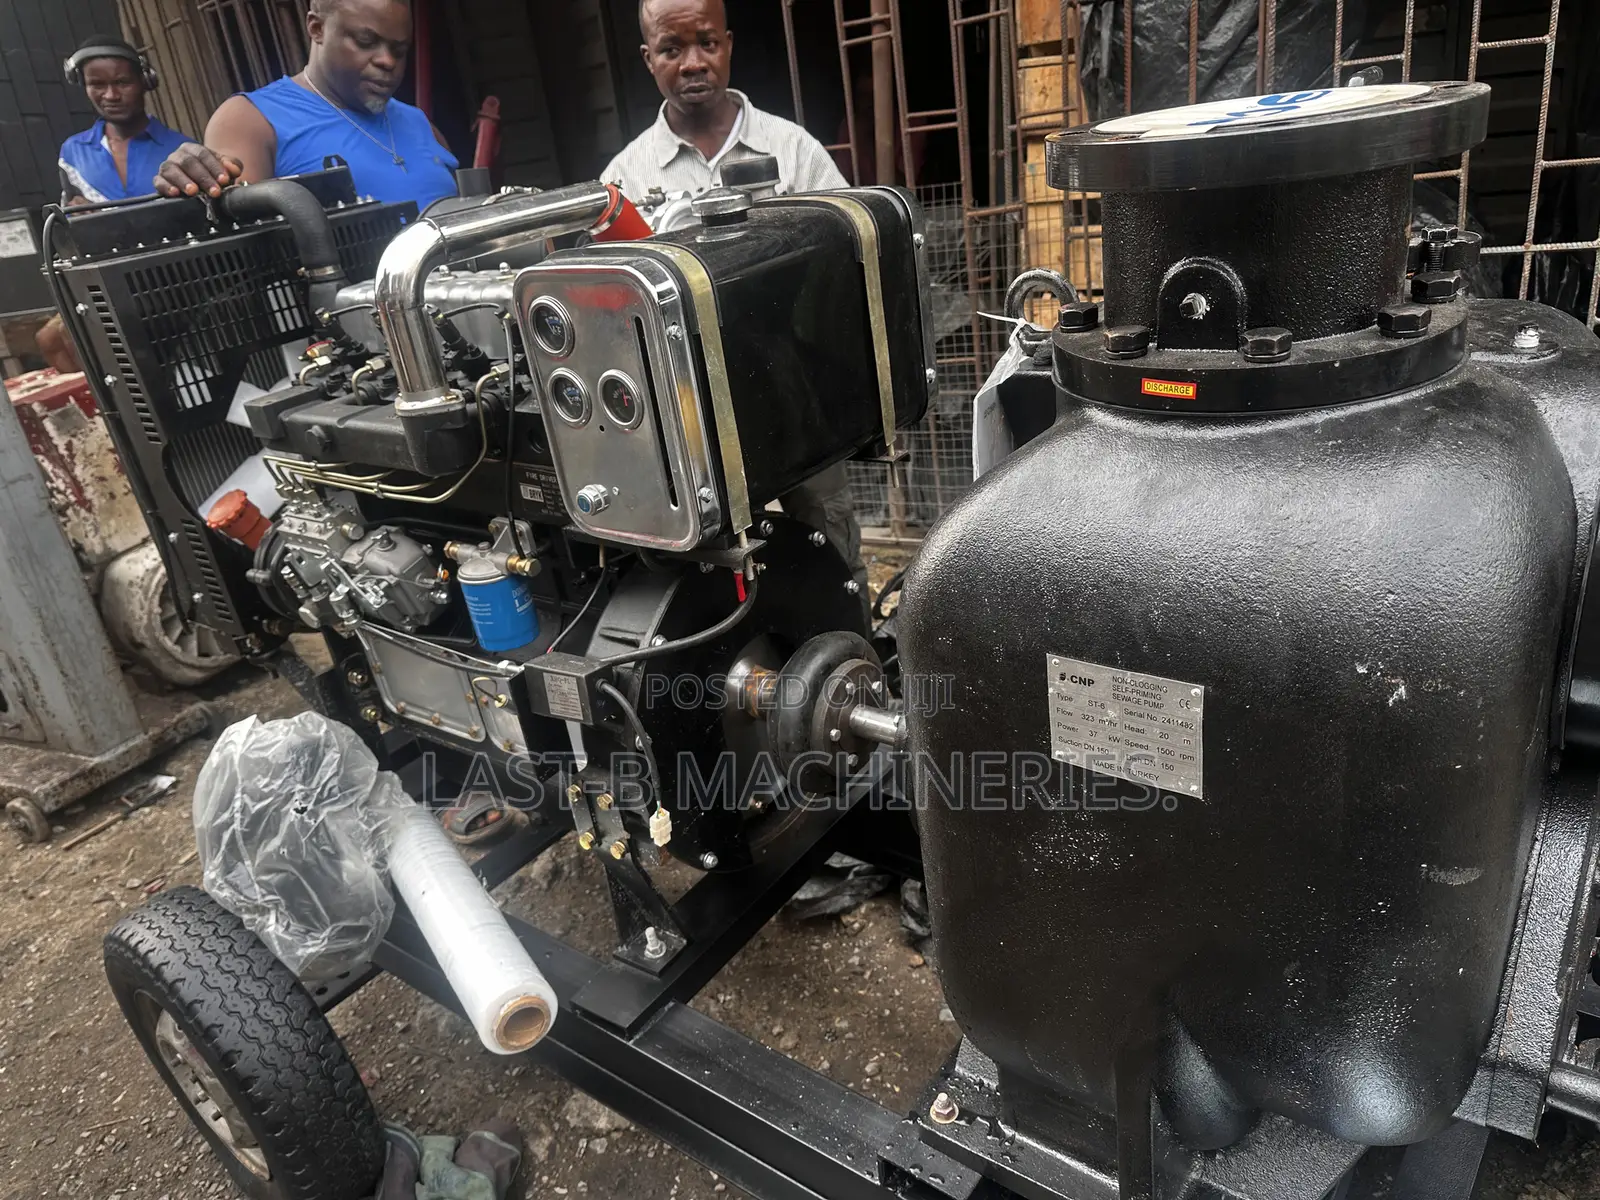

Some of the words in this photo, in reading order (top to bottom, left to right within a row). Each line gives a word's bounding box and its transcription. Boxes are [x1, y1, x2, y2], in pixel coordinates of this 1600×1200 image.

[1146, 382, 1190, 394] DISCHARGE
[1071, 675, 1095, 687] CNP
[1113, 675, 1168, 693] NON-CLOGGING
[1112, 683, 1161, 701] SELF-PRIMING
[1112, 692, 1142, 705] SEWAGE
[1144, 699, 1164, 710] PUMP
[1081, 713, 1095, 722] 323
[1124, 707, 1144, 719] Serial
[1162, 716, 1194, 730] 2411482
[1088, 729, 1098, 737] 37
[1109, 734, 1120, 743] kW
[1159, 732, 1169, 740] 20
[1084, 742, 1094, 751] DN
[1096, 745, 1109, 755] 150
[1157, 746, 1175, 757] 1500
[1180, 753, 1195, 762] rpm
[1093, 758, 1114, 771] MADE
[1117, 764, 1124, 773] IN
[1127, 767, 1160, 782] TURKEY
[1161, 761, 1174, 771] 150
